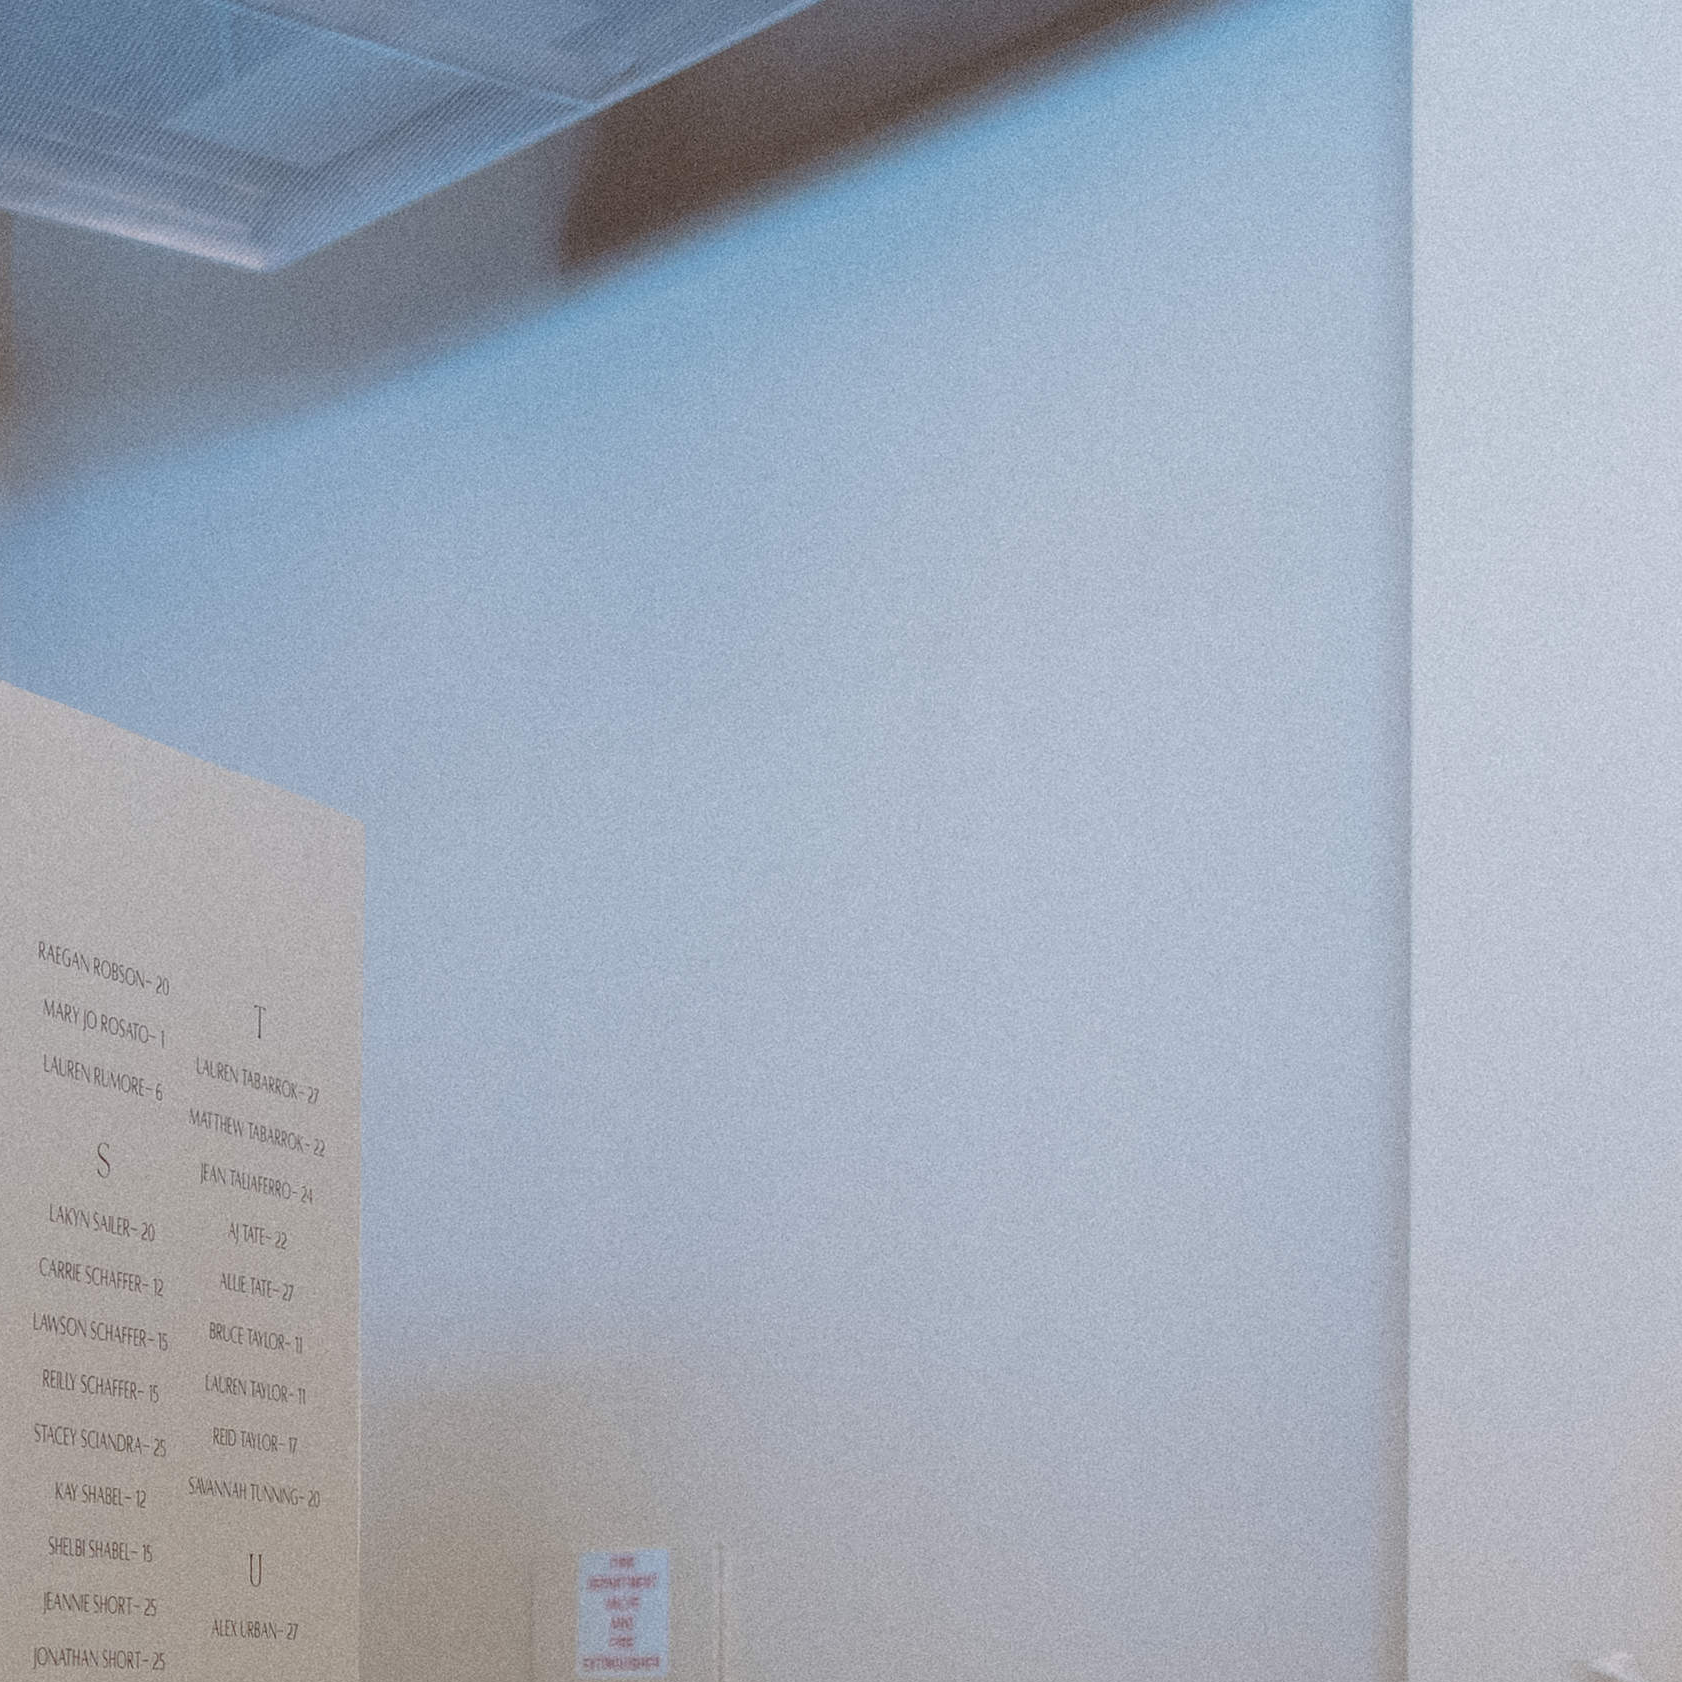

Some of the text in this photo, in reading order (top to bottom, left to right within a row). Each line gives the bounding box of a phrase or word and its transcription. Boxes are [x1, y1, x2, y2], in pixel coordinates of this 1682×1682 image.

[254, 1005, 266, 1039] T
[97, 1142, 110, 1179] S
[50, 1203, 89, 1227] LAKYN
[142, 1222, 155, 1242] 20
[39, 1257, 80, 1282] CARRIE
[154, 1278, 163, 1298] 12
[221, 1273, 245, 1293] ALLIE
[283, 1283, 293, 1301] 27
[56, 1482, 77, 1501] KAY
[137, 1490, 146, 1508] 12
[249, 1553, 262, 1588] U
